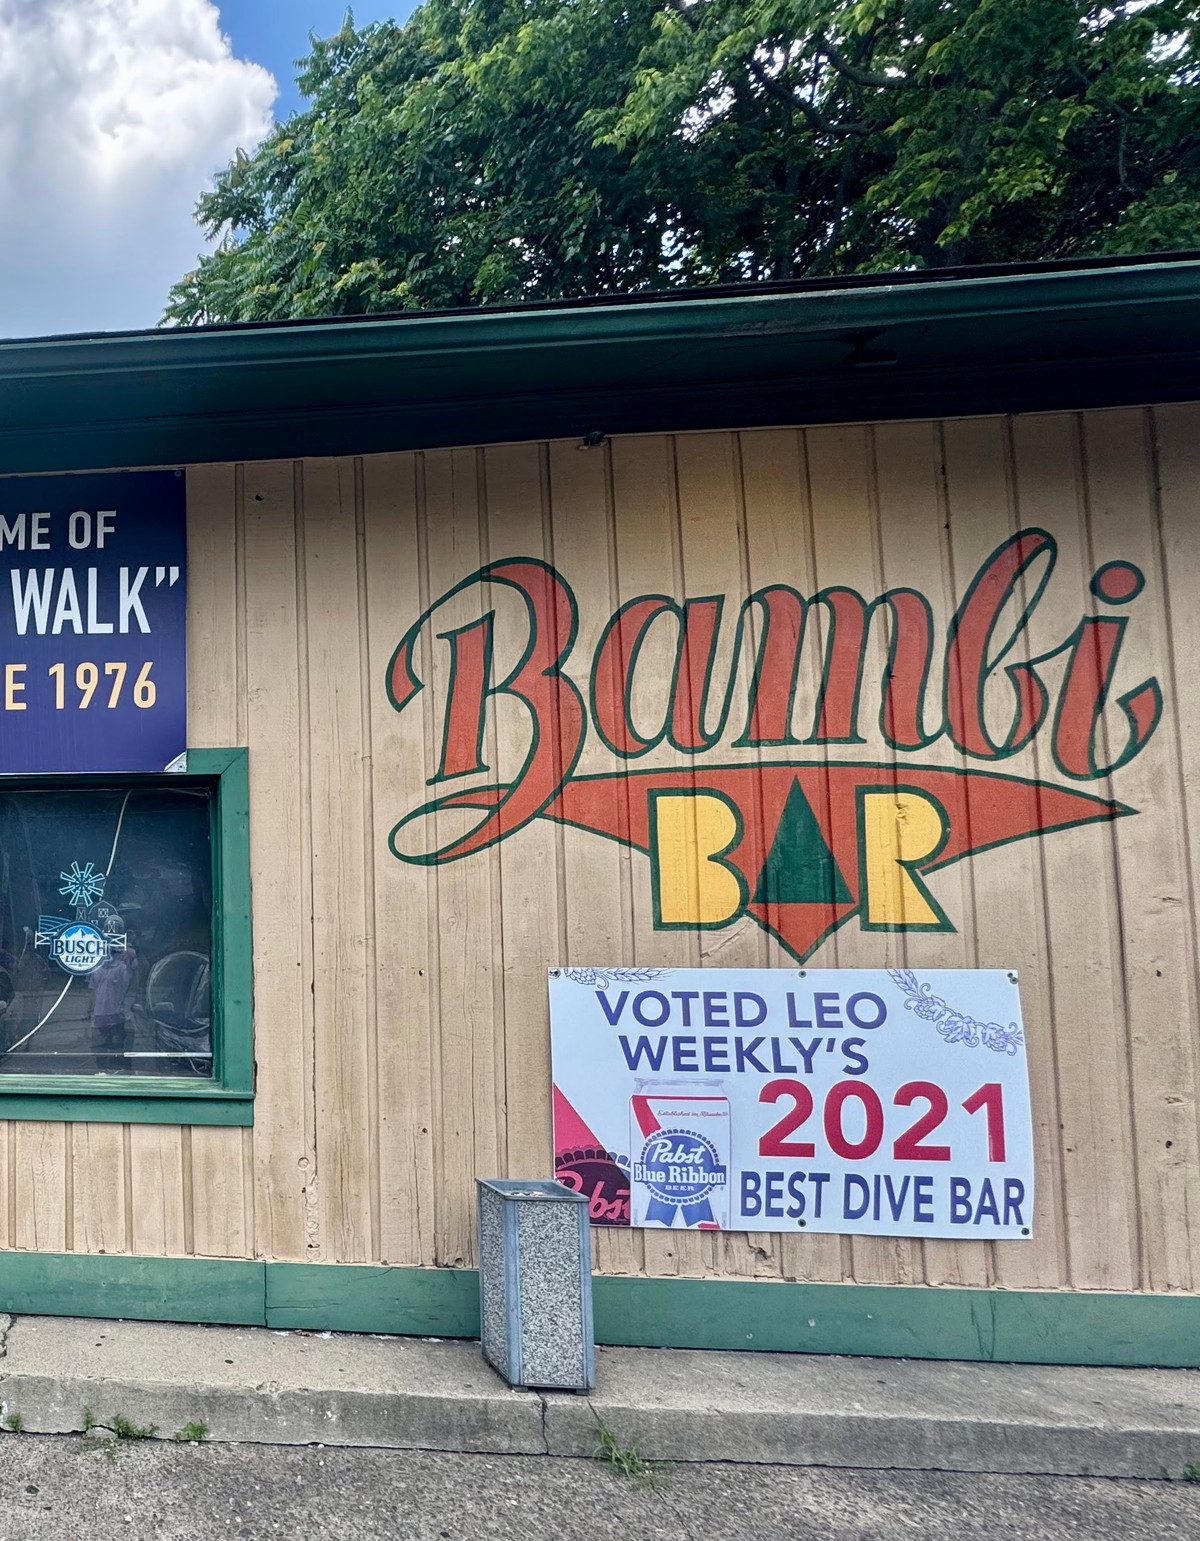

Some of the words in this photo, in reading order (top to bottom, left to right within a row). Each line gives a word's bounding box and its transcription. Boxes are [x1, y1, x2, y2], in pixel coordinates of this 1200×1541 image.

[68, 510, 117, 549] OF
[48, 661, 157, 710] 1976
[386, 526, 1163, 866] Bambi
[54, 940, 106, 956] BUSCH
[595, 990, 768, 1028] VOTED
[786, 991, 888, 1030] LEO
[618, 1034, 870, 1076] WEEKLY'S
[757, 1078, 1007, 1163] 2021
[650, 1138, 707, 1164] Pabst
[634, 1162, 666, 1182] Blue
[668, 1165, 725, 1185] Ribbon
[740, 1170, 830, 1219] BEST
[843, 1174, 934, 1224] DIVE
[949, 1177, 1026, 1227] BAR
